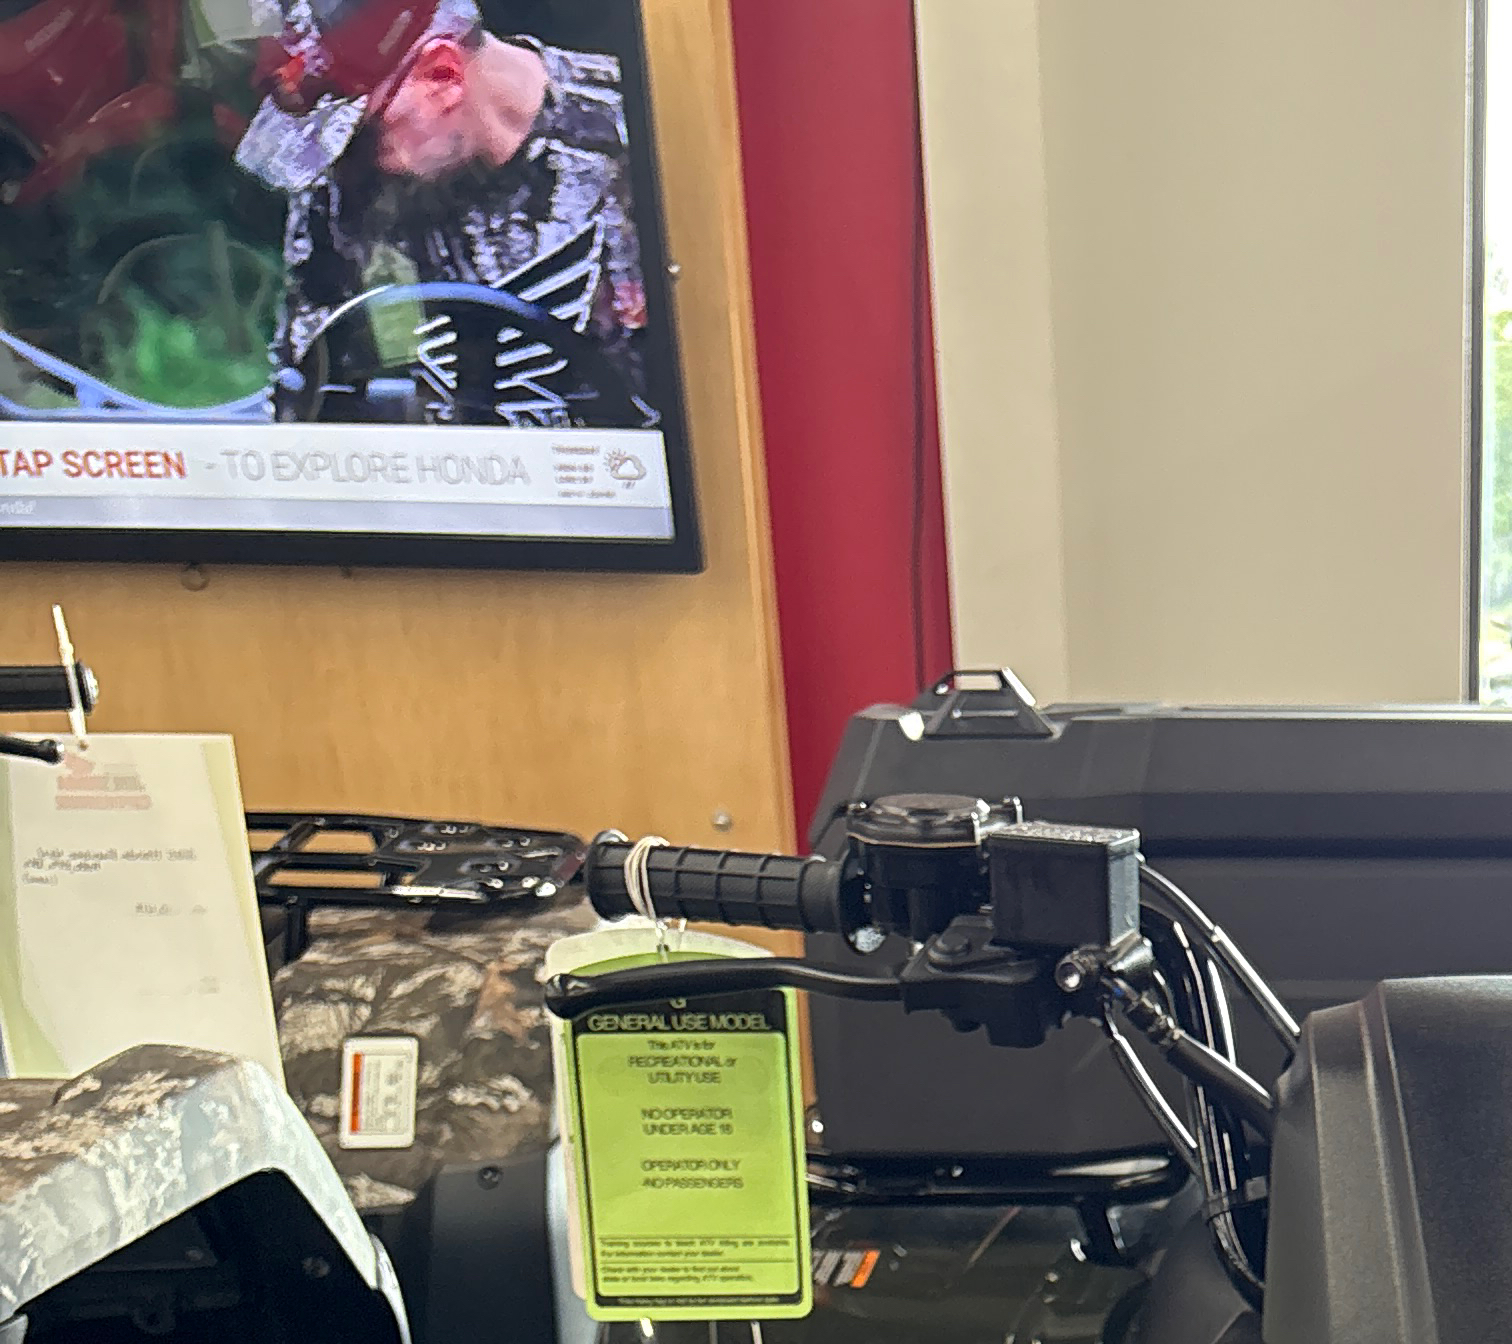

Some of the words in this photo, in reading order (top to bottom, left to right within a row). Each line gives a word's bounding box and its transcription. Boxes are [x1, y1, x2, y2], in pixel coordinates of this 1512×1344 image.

[0, 450, 53, 477] TAP
[61, 450, 187, 478] SCREEN
[220, 450, 265, 481] TO
[272, 450, 412, 484] EXPLORE
[416, 453, 532, 485] HONDA
[587, 1013, 670, 1031] GENERAL
[671, 1013, 708, 1030] USE
[709, 1013, 771, 1030] MODEL
[628, 1056, 722, 1067] RECREATIONAL
[647, 1072, 694, 1084] UTILITY
[695, 1072, 721, 1084] USE
[641, 1108, 662, 1119] NO
[662, 1108, 733, 1119] OPERATOR
[642, 1123, 689, 1135] UNDER
[691, 1123, 717, 1135] AGE
[641, 1160, 705, 1171] OPERATOR
[707, 1160, 741, 1171] ONLY
[665, 1177, 744, 1188] PASSENGERS
